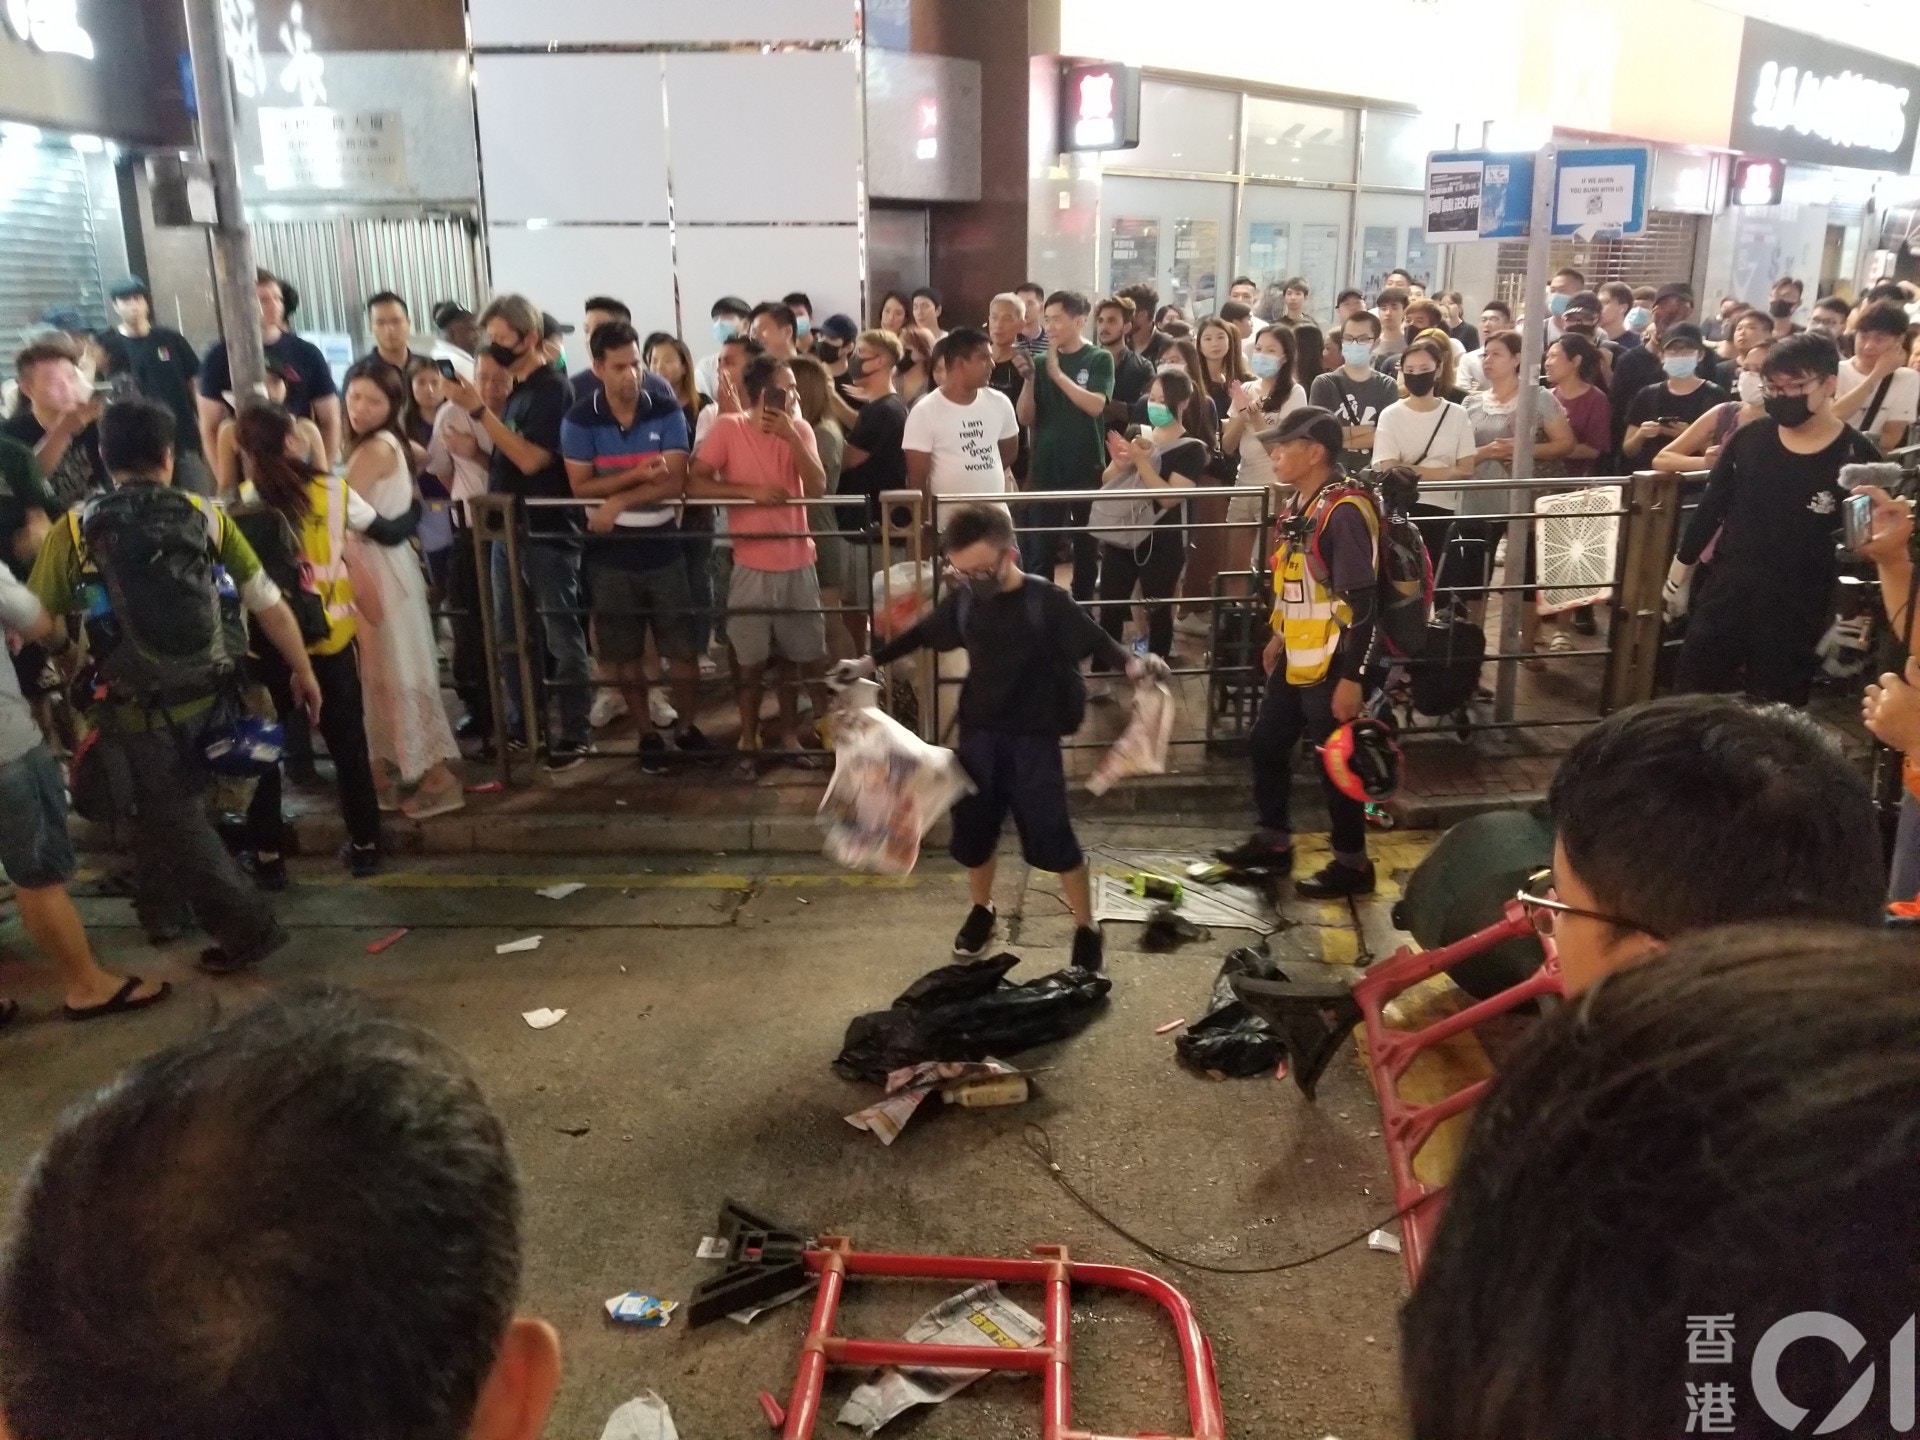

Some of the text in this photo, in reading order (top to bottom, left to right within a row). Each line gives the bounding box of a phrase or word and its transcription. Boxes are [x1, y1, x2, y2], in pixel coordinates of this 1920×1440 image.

[968, 420, 983, 428] am
[959, 429, 984, 439] really
[961, 440, 976, 452] not
[970, 445, 992, 457] good
